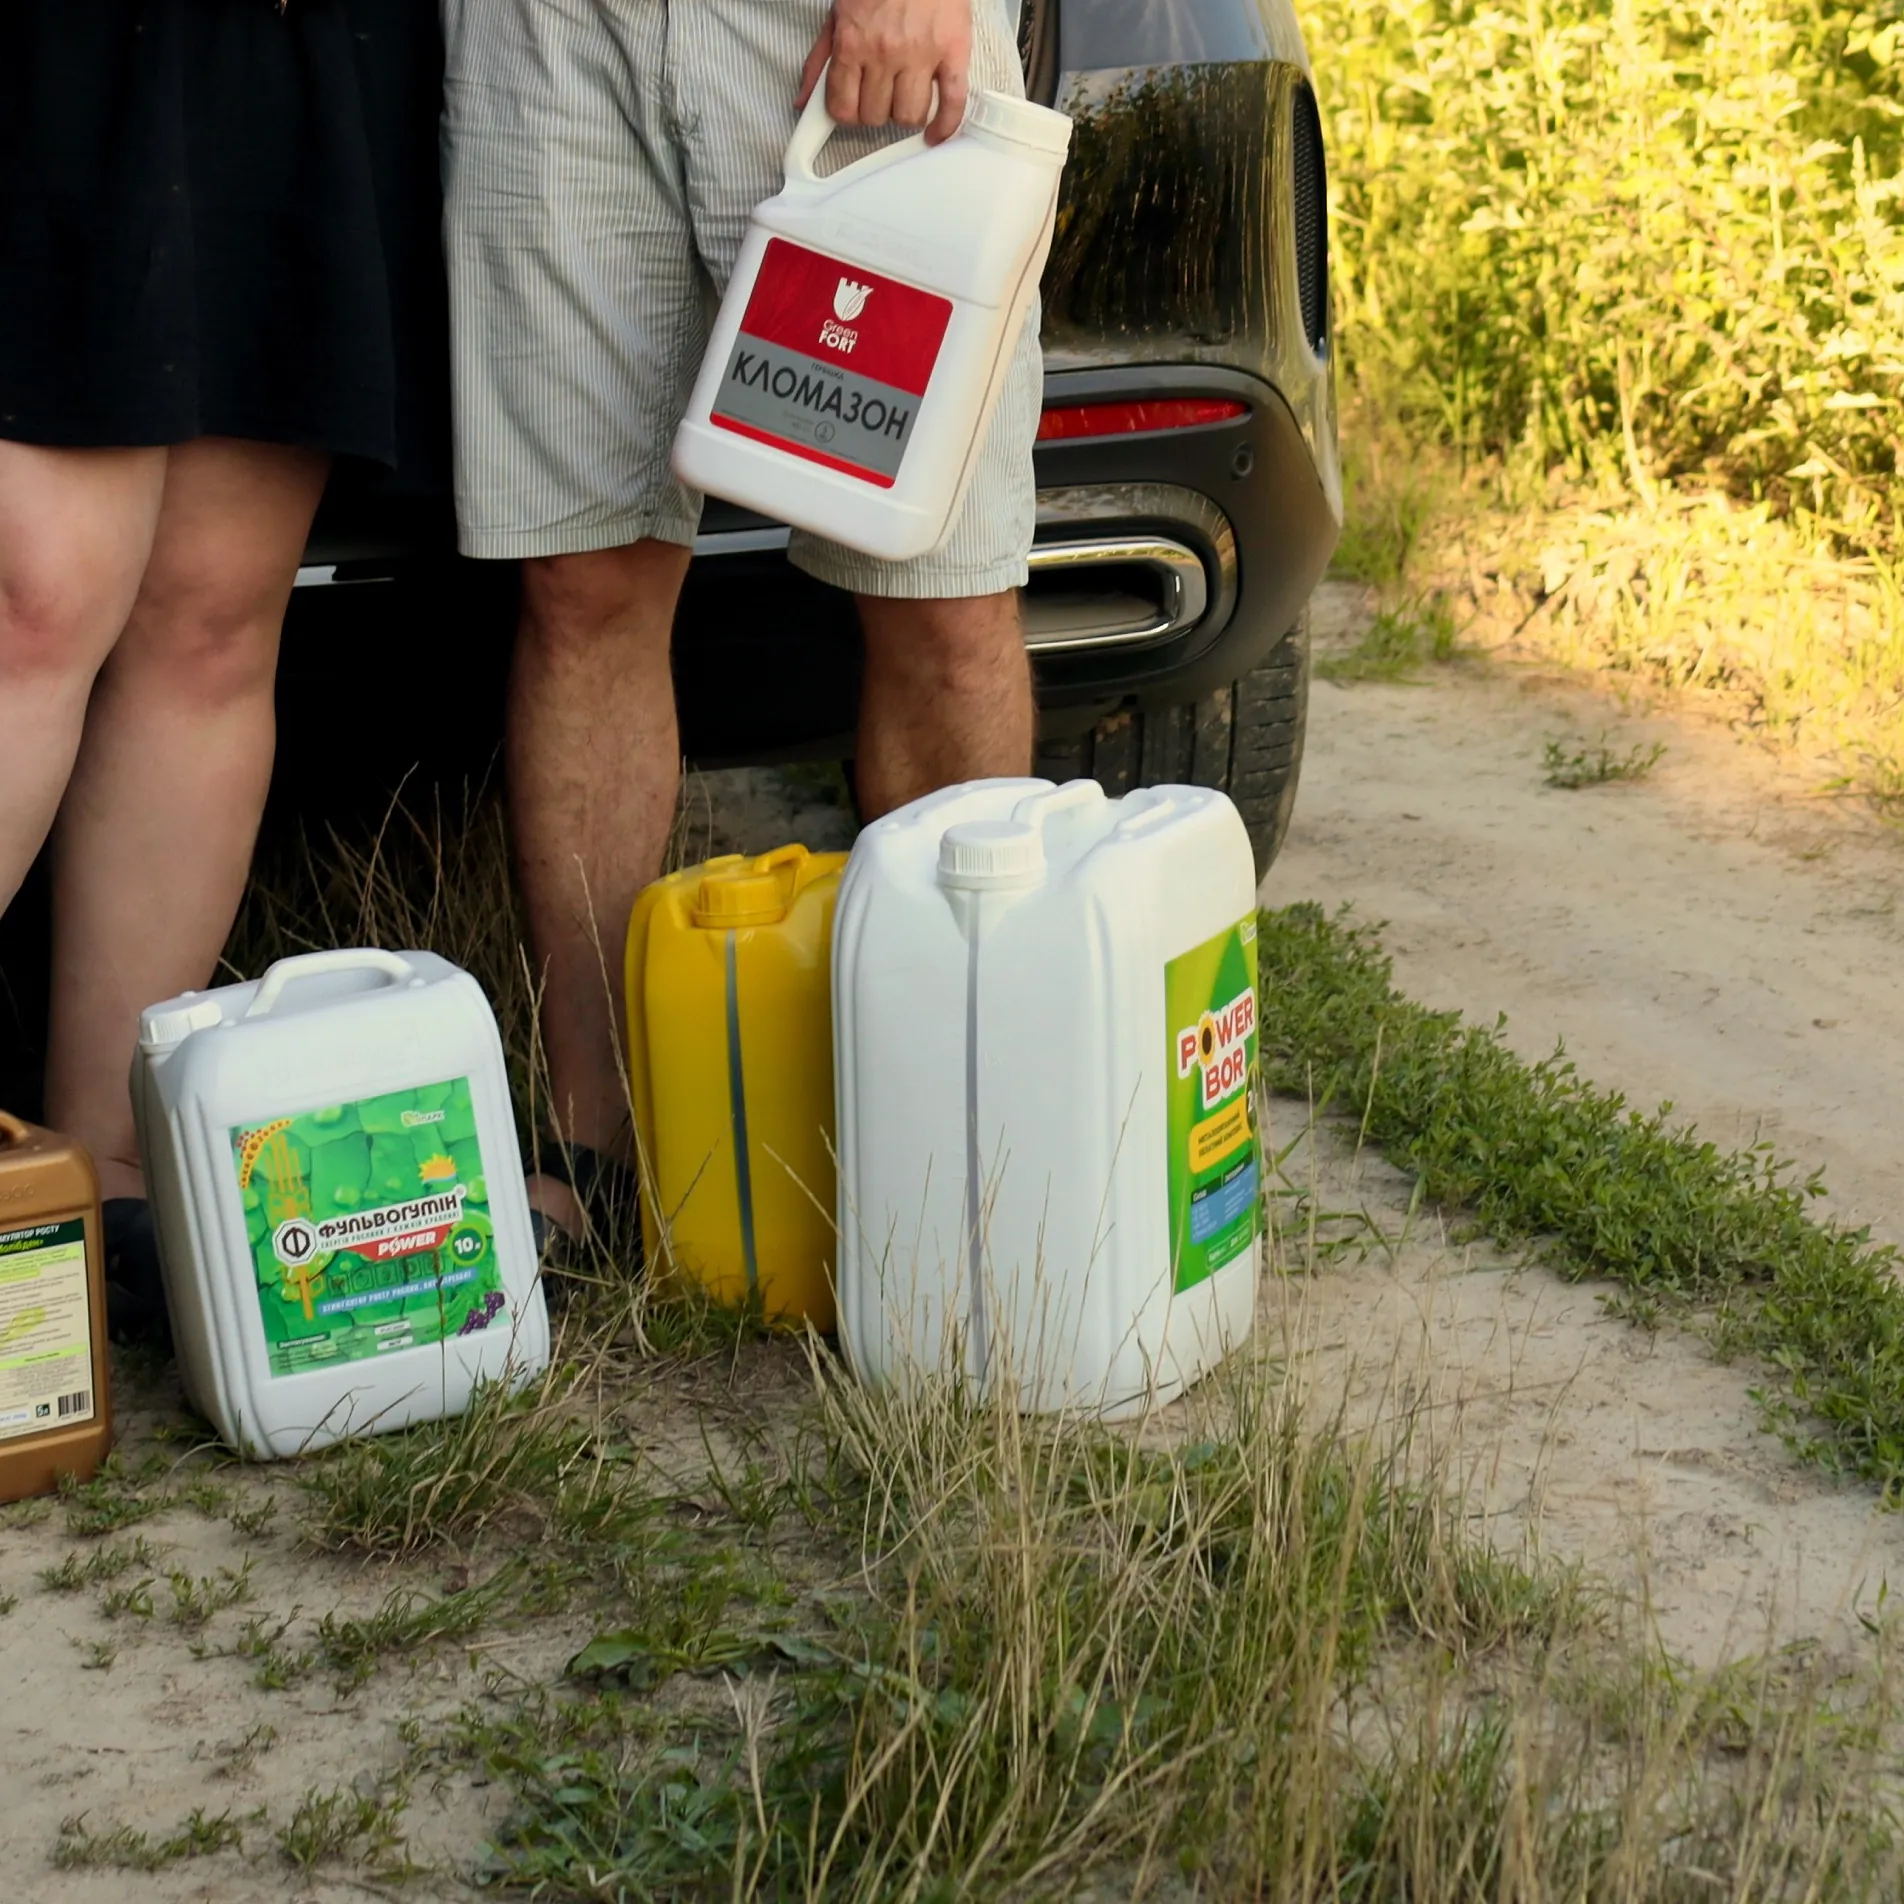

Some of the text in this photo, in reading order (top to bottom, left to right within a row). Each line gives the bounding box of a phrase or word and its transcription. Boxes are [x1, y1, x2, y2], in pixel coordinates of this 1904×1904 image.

[818, 328, 857, 354] FORT
[823, 318, 859, 340] Green
[731, 350, 910, 441] КЛОМАЗОН
[1206, 1047, 1244, 1101] BOR
[377, 1230, 437, 1257] POWER
